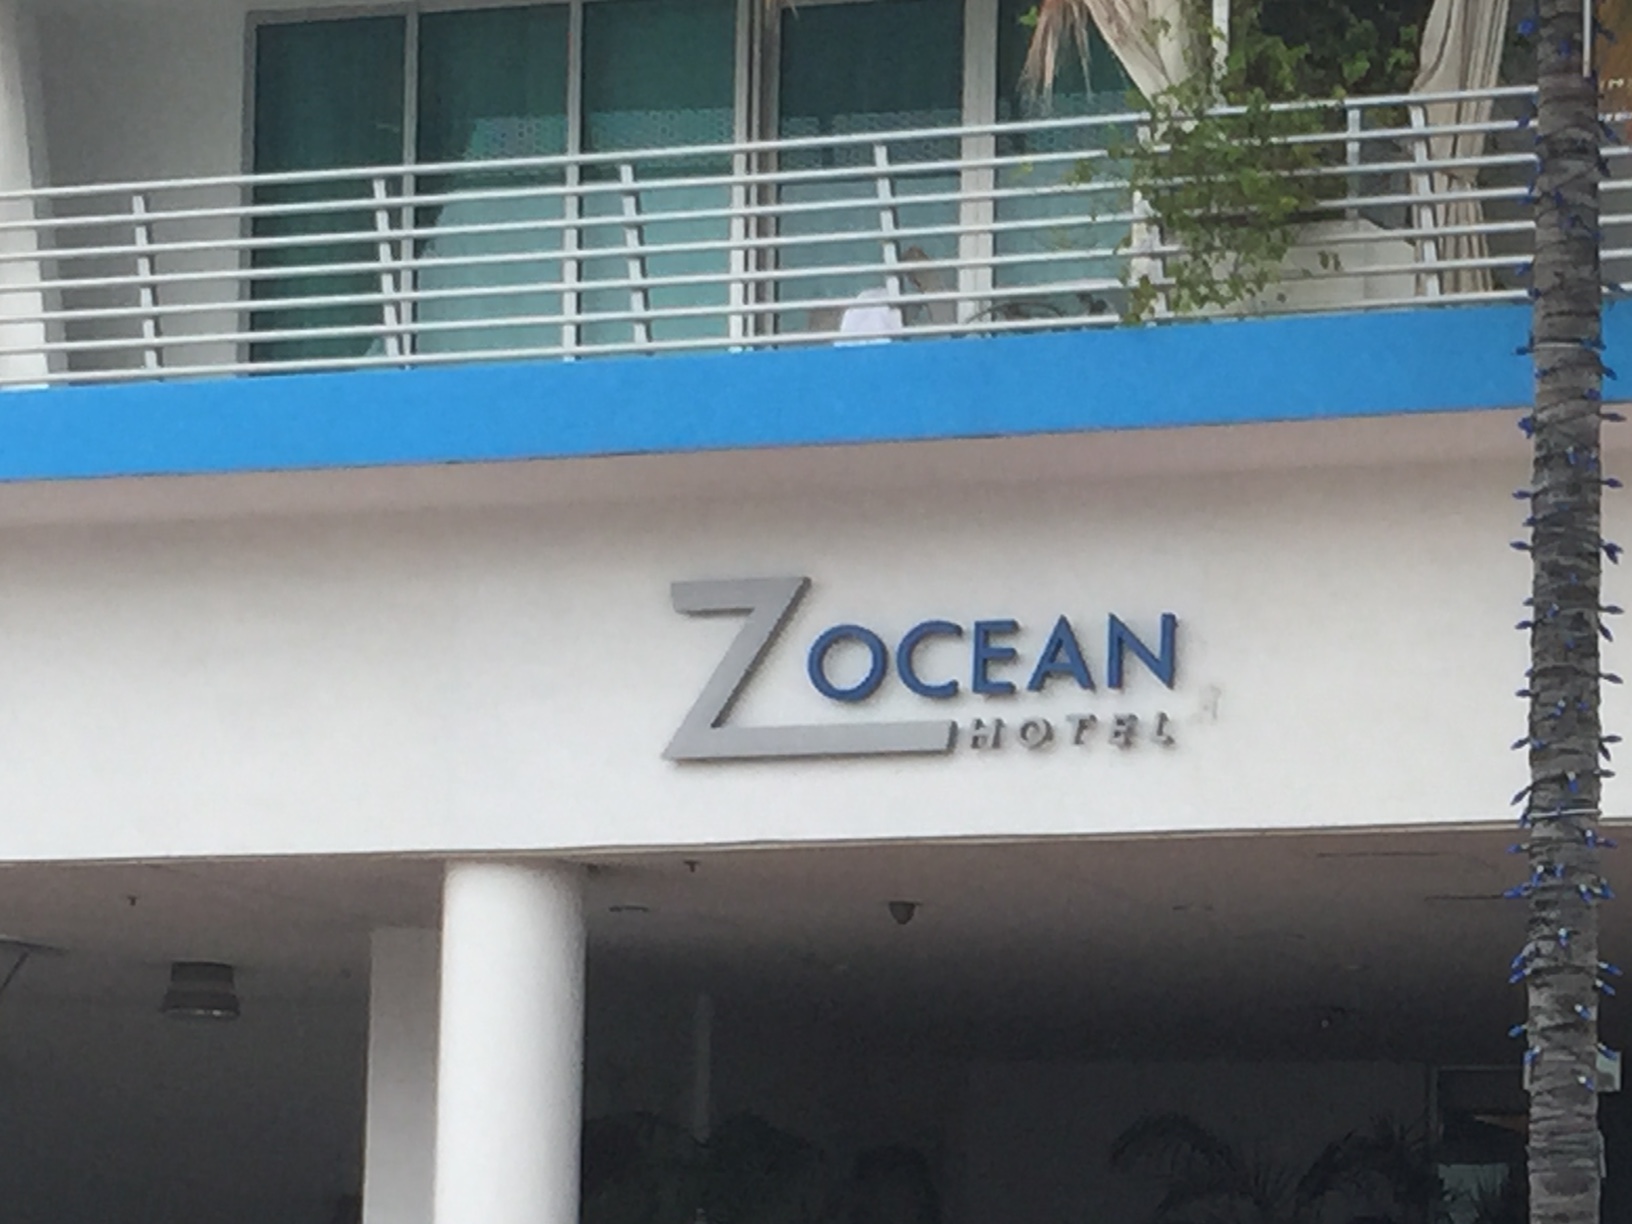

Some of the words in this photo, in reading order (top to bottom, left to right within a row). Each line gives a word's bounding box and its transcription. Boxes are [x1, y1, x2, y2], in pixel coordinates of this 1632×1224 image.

[662, 576, 958, 764] Z
[807, 612, 1180, 703] OCEAN
[970, 711, 1176, 750] HOTEL
